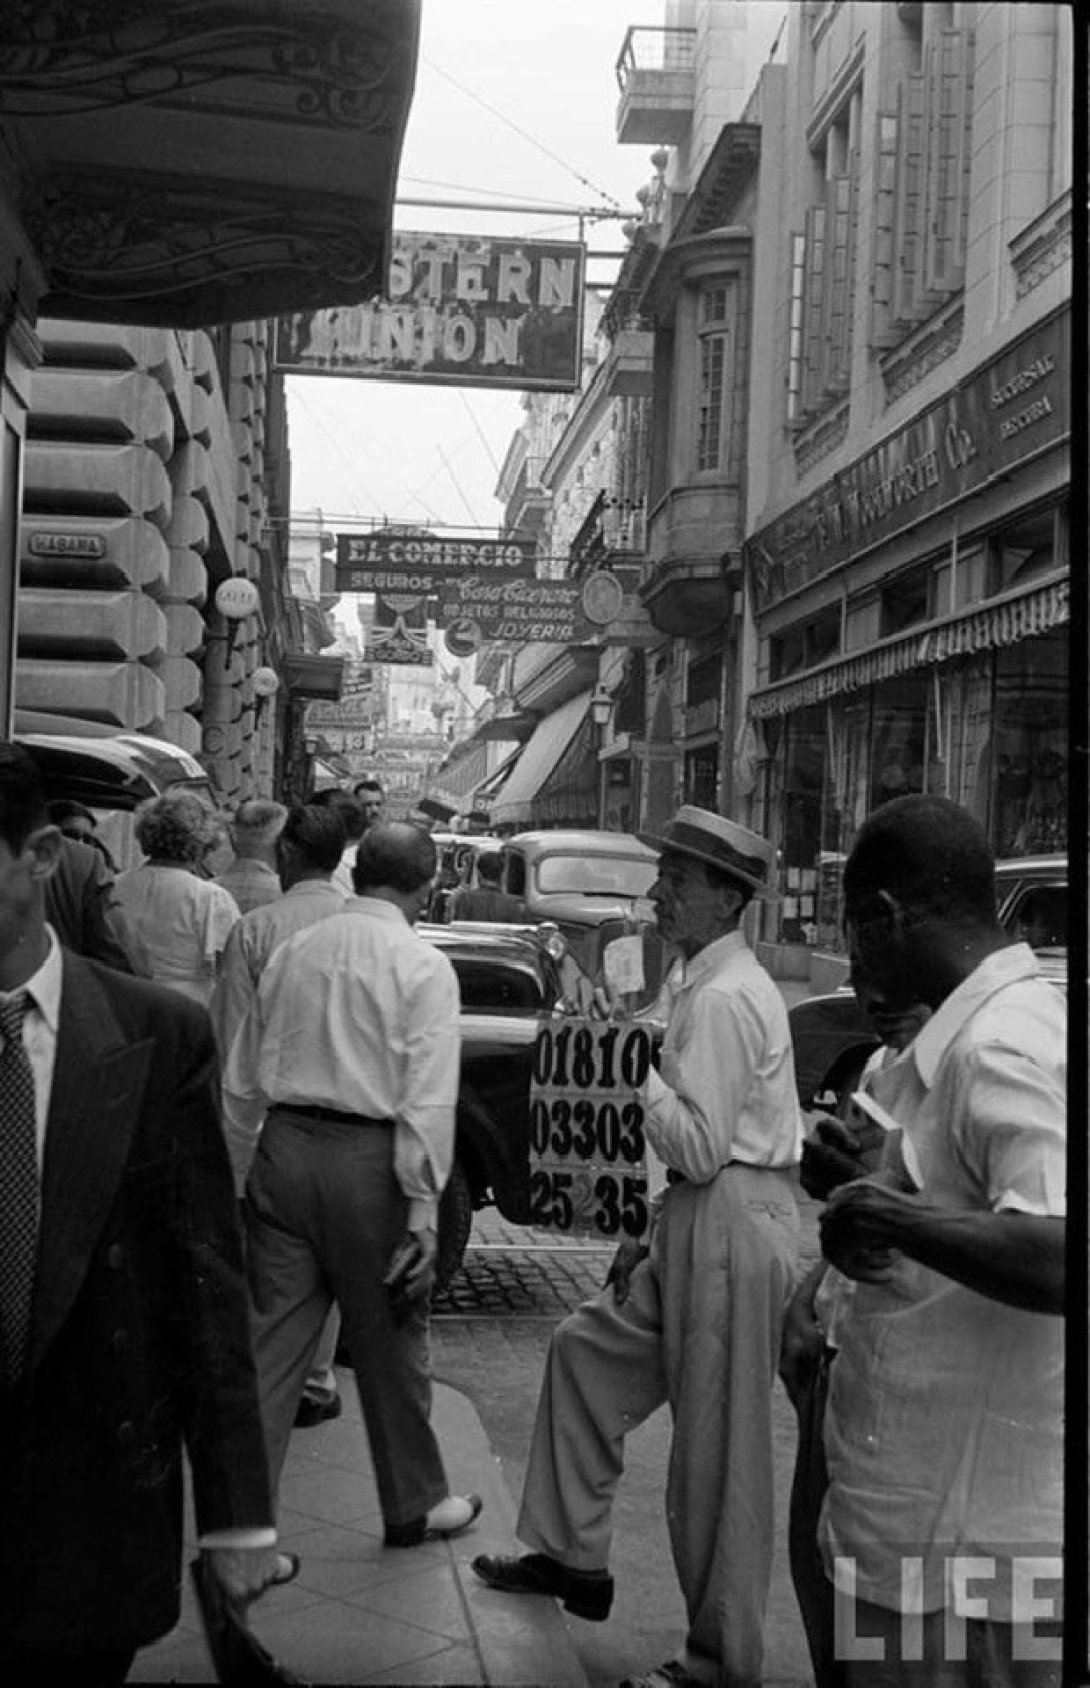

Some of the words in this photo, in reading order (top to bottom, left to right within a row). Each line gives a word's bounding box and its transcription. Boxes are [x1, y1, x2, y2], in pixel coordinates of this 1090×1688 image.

[348, 540, 382, 562] EL
[388, 542, 523, 567] COMERCIO
[351, 571, 433, 590] SEGUROS
[533, 1026, 650, 1088] 01810
[531, 1100, 645, 1163] 03303
[531, 1171, 573, 1230] 25
[596, 1175, 648, 1236] 35
